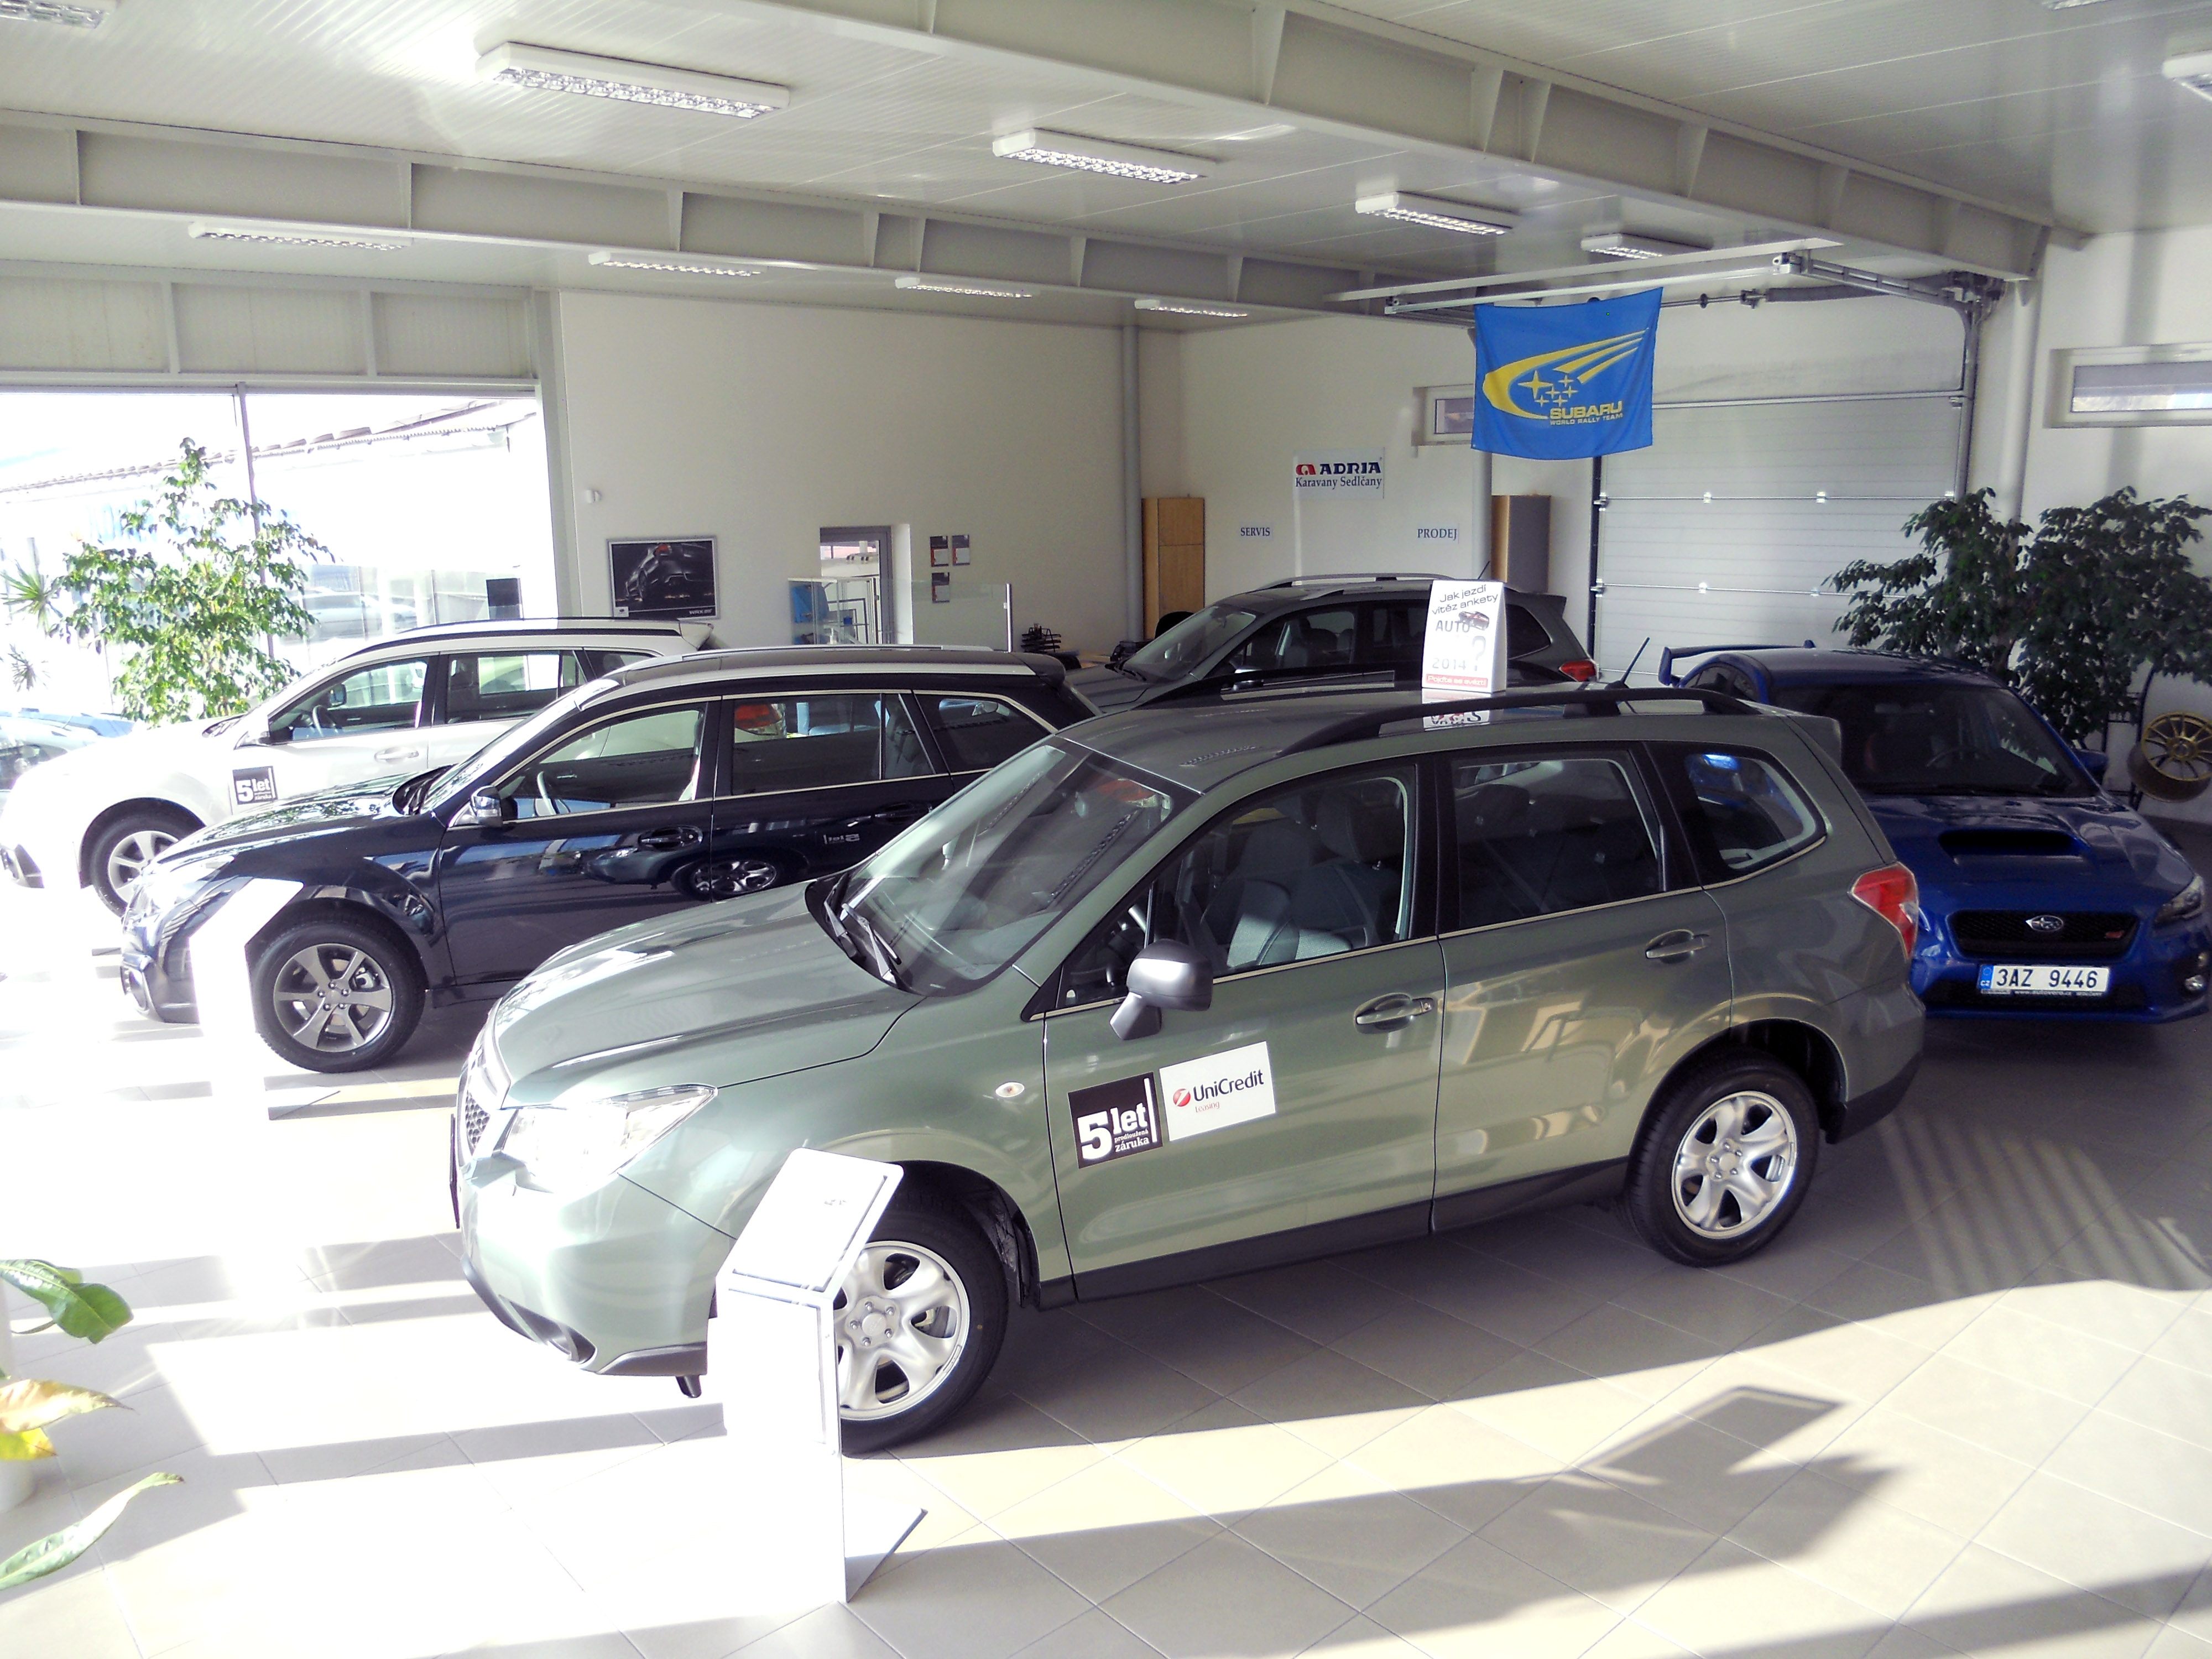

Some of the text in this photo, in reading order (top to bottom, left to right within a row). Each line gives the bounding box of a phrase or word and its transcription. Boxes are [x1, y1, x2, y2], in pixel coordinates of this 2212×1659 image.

[1550, 400, 1623, 420] SUBARU
[1319, 462, 1381, 475] ADRIA
[1295, 476, 1383, 490] Karavany Sedlčany
[1240, 527, 1270, 536] SERVIS
[1417, 528, 1457, 541] PRODEJ
[1439, 584, 1486, 603] Jak jezdí
[1432, 594, 1498, 615] vítěz ankety
[1435, 620, 1470, 633] AUTO
[1432, 657, 1467, 671] 2014
[236, 778, 270, 802] 5 let
[1996, 968, 2098, 988] 3AZ 9446
[1193, 1068, 1264, 1102] UniCredit
[1195, 1101, 1220, 1113] Leasing
[1077, 1102, 1148, 1161] 5 let
[1114, 1128, 1149, 1144] prodloužená
[1115, 1136, 1150, 1152] záruka
